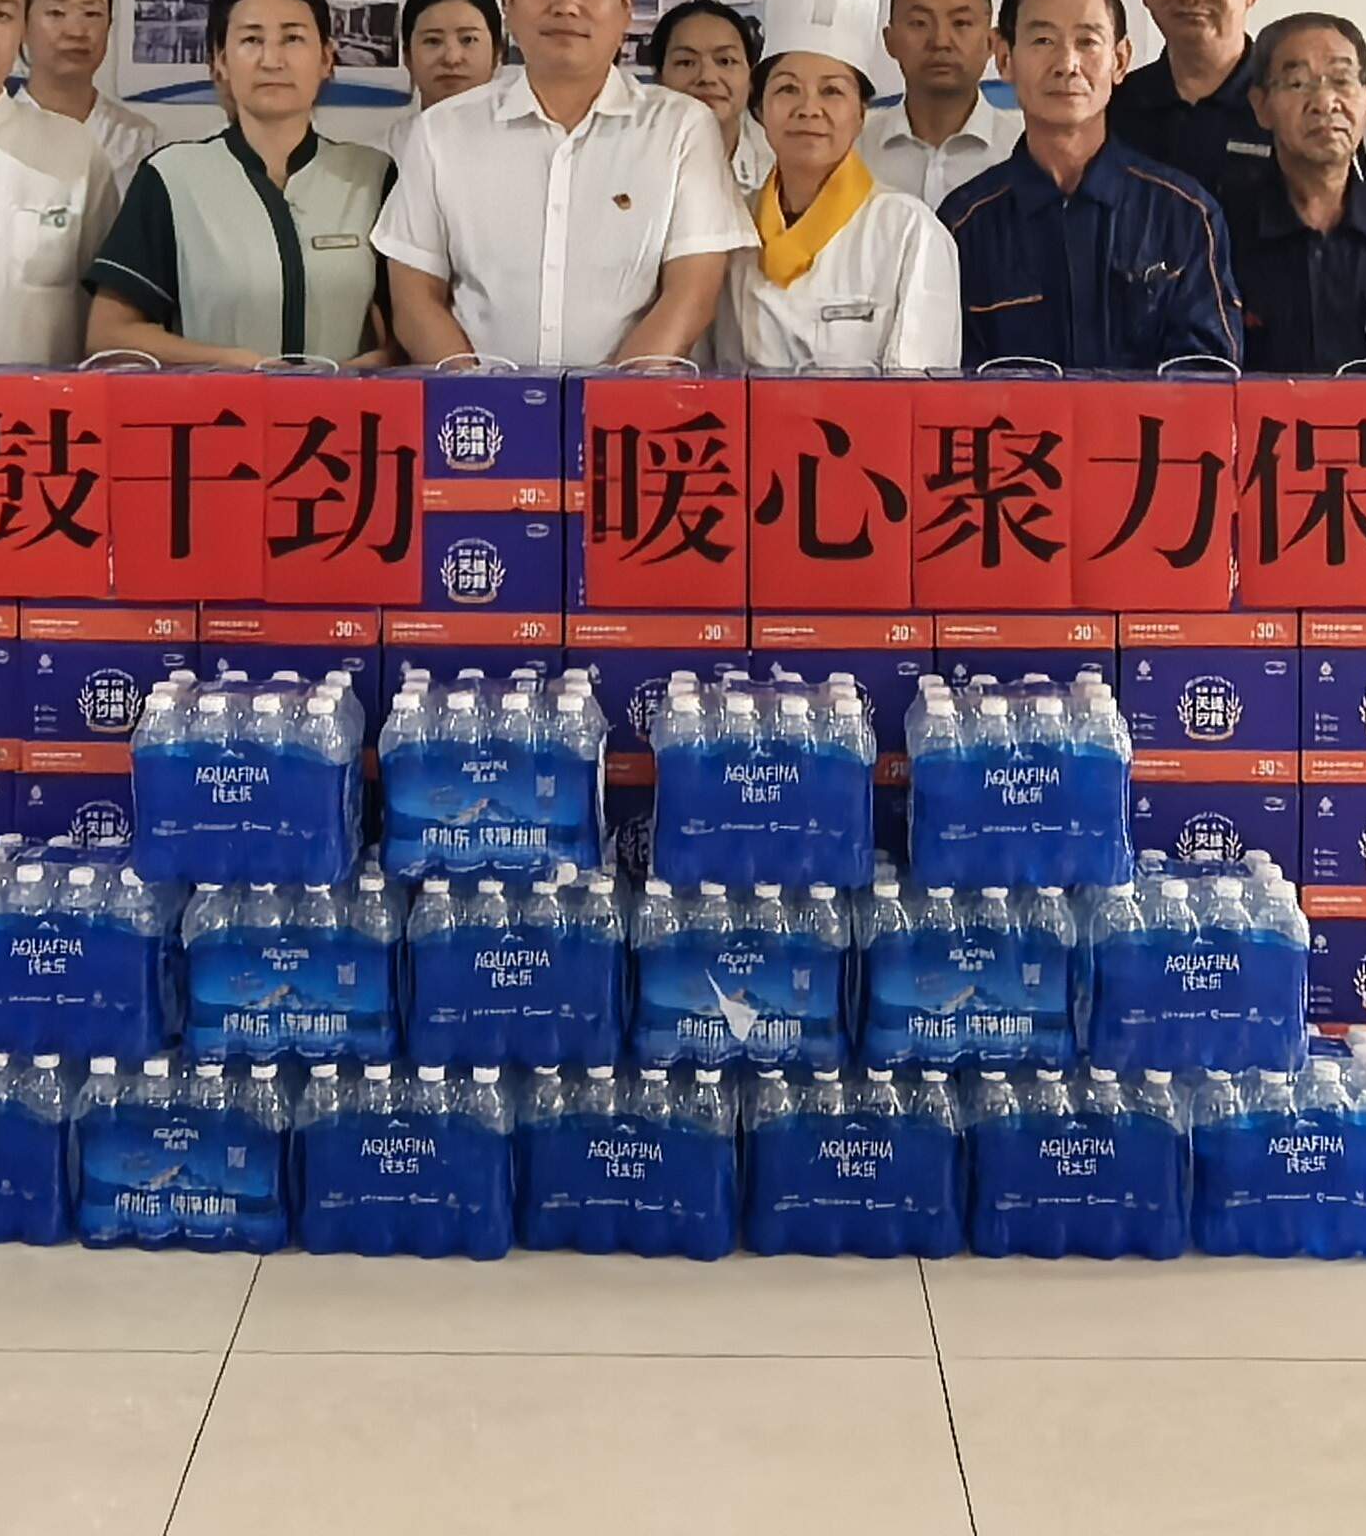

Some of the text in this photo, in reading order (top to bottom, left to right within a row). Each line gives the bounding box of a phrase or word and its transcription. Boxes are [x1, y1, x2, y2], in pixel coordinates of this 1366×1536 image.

[195, 766, 269, 786] AQUAFINA
[724, 764, 799, 784] AQUAFINA
[985, 767, 1060, 787] AQUAFINA
[11, 938, 83, 958] AQUAFINA
[474, 950, 551, 970] AQUAFINA
[1165, 954, 1240, 975] AQUAFINA
[361, 1137, 436, 1158] AQUAFINA
[587, 1140, 663, 1162] AQUAFINA
[818, 1139, 894, 1161] AQUAFINA
[1039, 1138, 1115, 1159] AQUAFINA
[1268, 1135, 1344, 1156] AQUAFINA
